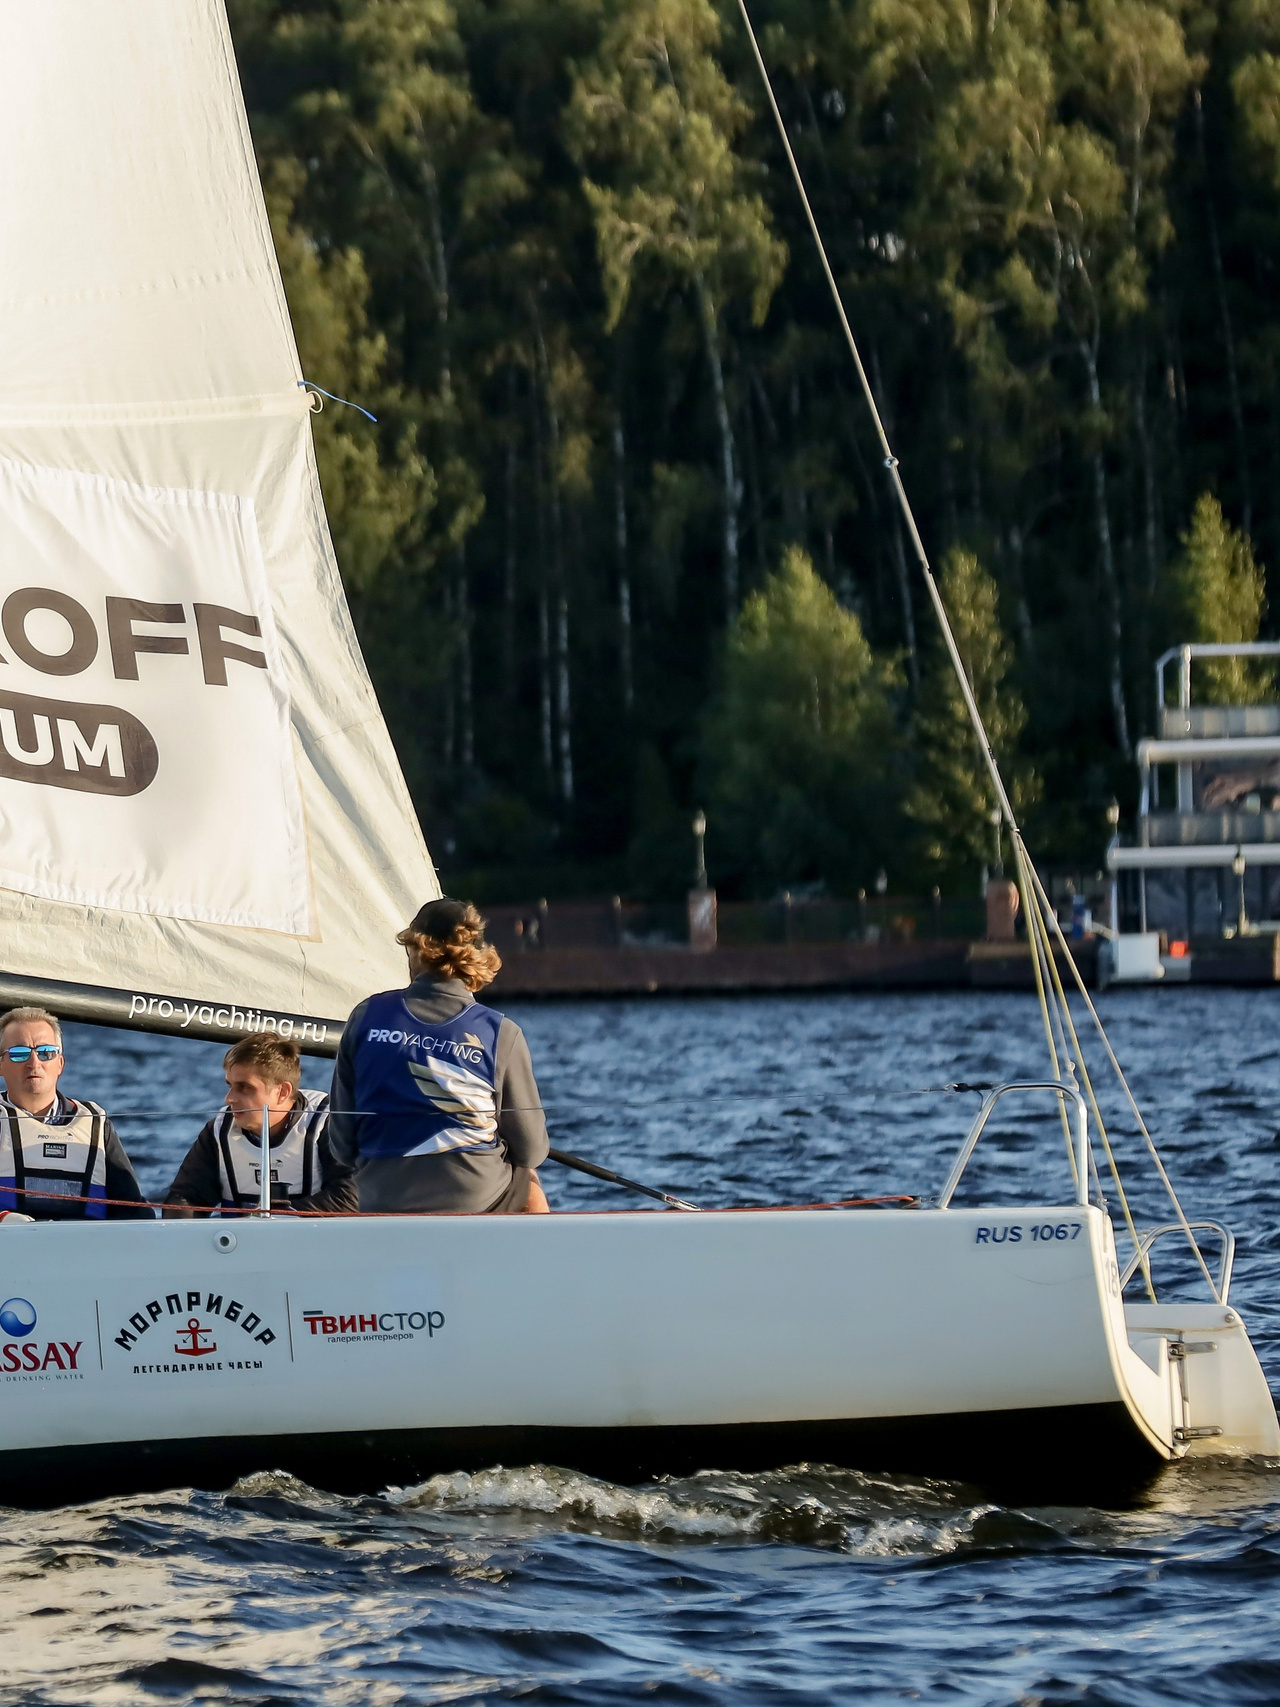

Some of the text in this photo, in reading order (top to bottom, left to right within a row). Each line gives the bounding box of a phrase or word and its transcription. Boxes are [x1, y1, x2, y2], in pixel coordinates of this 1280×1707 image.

[128, 994, 328, 1043] pro-yachting.ru
[367, 1028, 483, 1063] PROYACHTING
[975, 1223, 1083, 1244] RUS 1067
[114, 1291, 277, 1352] МОРПРИБОР
[327, 1332, 414, 1344] галерея интерьеров
[133, 1360, 263, 1374] ЛЕГЕНДАРНЫЕ ЧАСЫ
[6, 1374, 51, 1382] DRINKING
